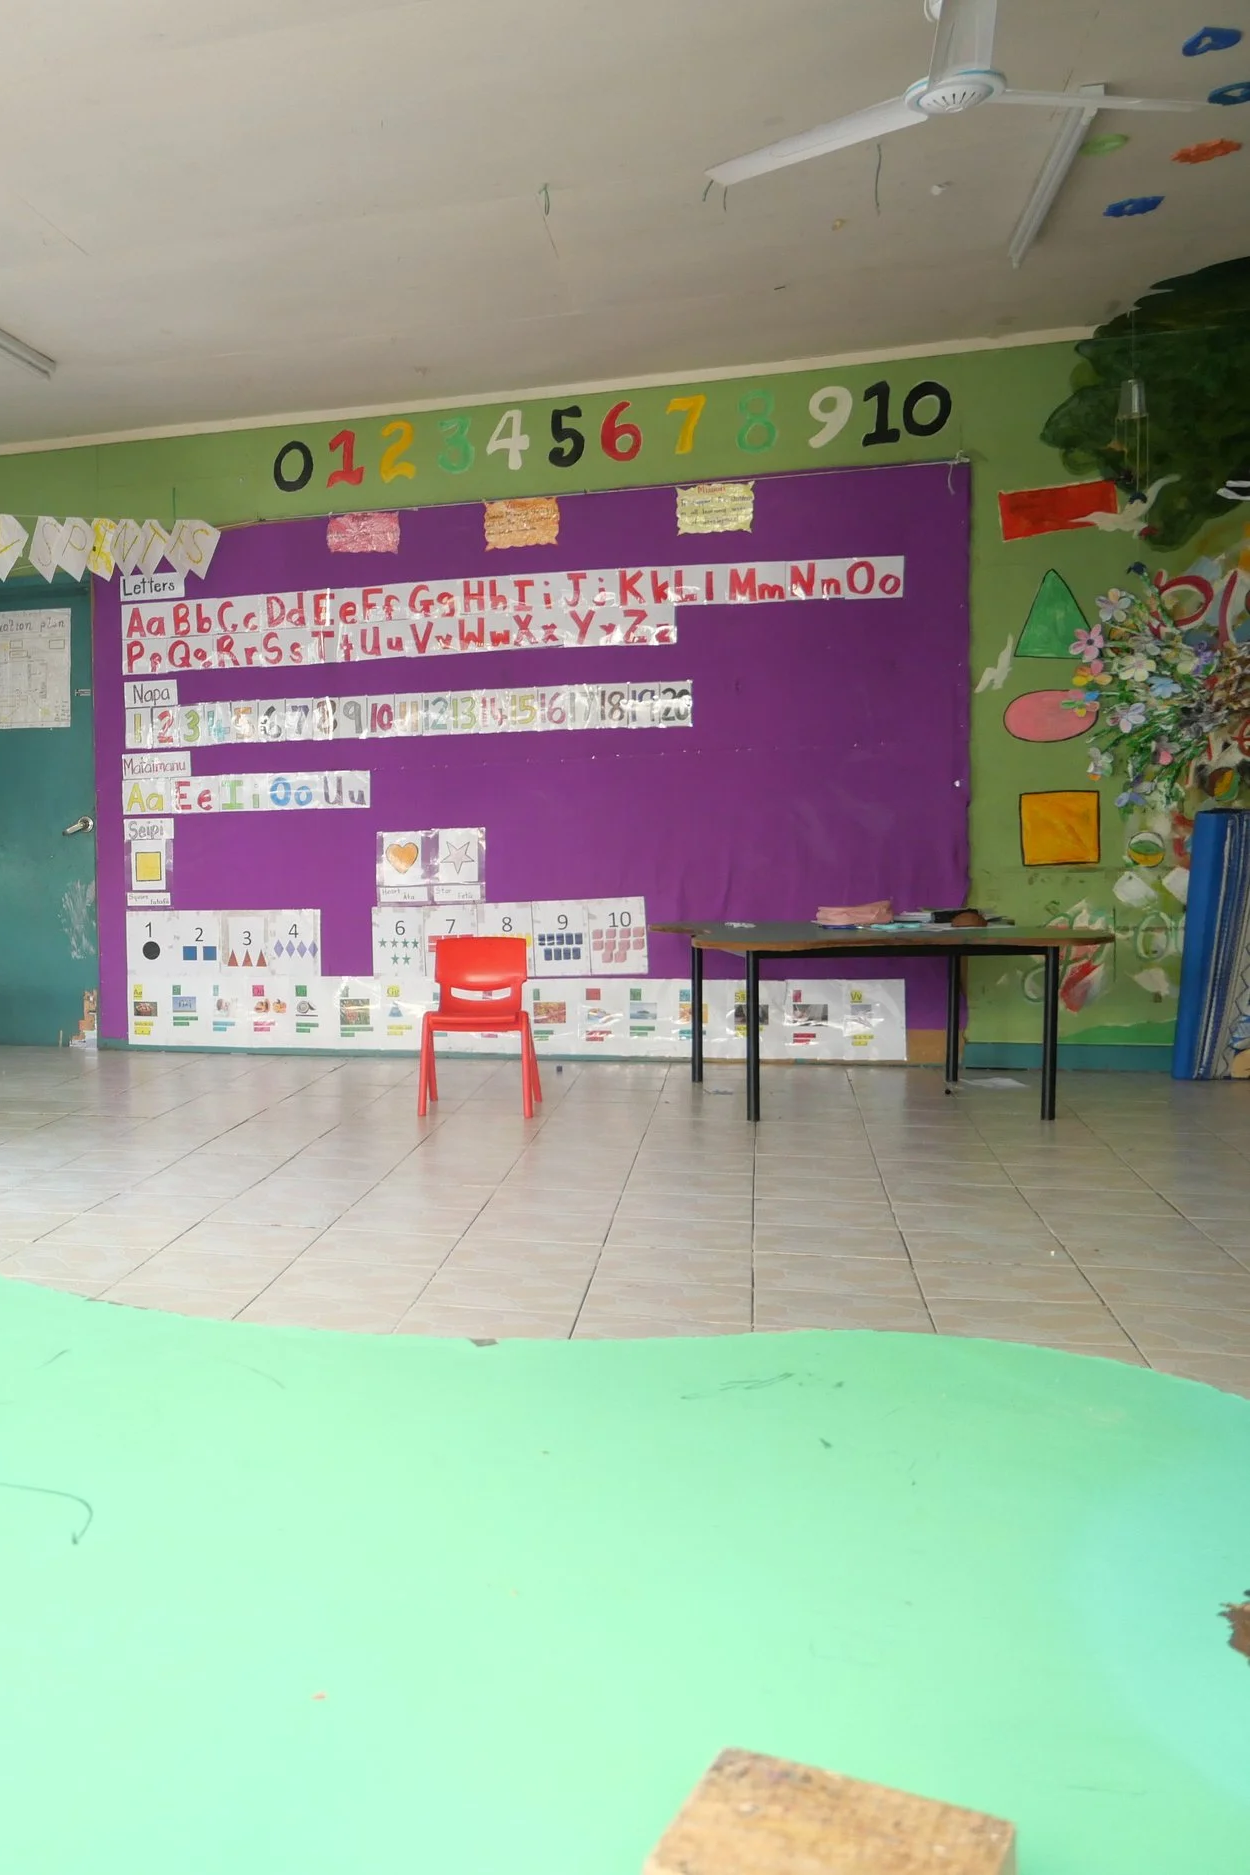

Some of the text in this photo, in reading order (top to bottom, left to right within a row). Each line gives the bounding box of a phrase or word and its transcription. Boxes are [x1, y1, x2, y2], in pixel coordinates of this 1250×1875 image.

[274, 380, 952, 492] 0 1 2 3 4 5 6 7 8 9 10
[123, 577, 175, 596] Letters
[40, 617, 65, 632] plan
[133, 684, 170, 704] Napa
[134, 714, 141, 743] 1
[157, 711, 174, 743] 2
[183, 710, 199, 742] 3
[207, 711, 230, 742] 4
[234, 707, 254, 740] 5
[260, 706, 282, 738] 6
[291, 705, 309, 734] 7
[342, 701, 362, 734] 9
[370, 703, 393, 733] 10
[399, 701, 419, 732] 11
[424, 698, 448, 731] 12
[451, 697, 477, 730] 13
[480, 697, 507, 727] 14
[510, 694, 536, 725] 15
[540, 692, 566, 724] 16
[600, 690, 625, 722] 18
[661, 688, 691, 722] 20
[128, 820, 164, 840] Seipi
[145, 922, 299, 945] 1 2 3 4
[395, 911, 632, 936] 6 7 8 9 10
